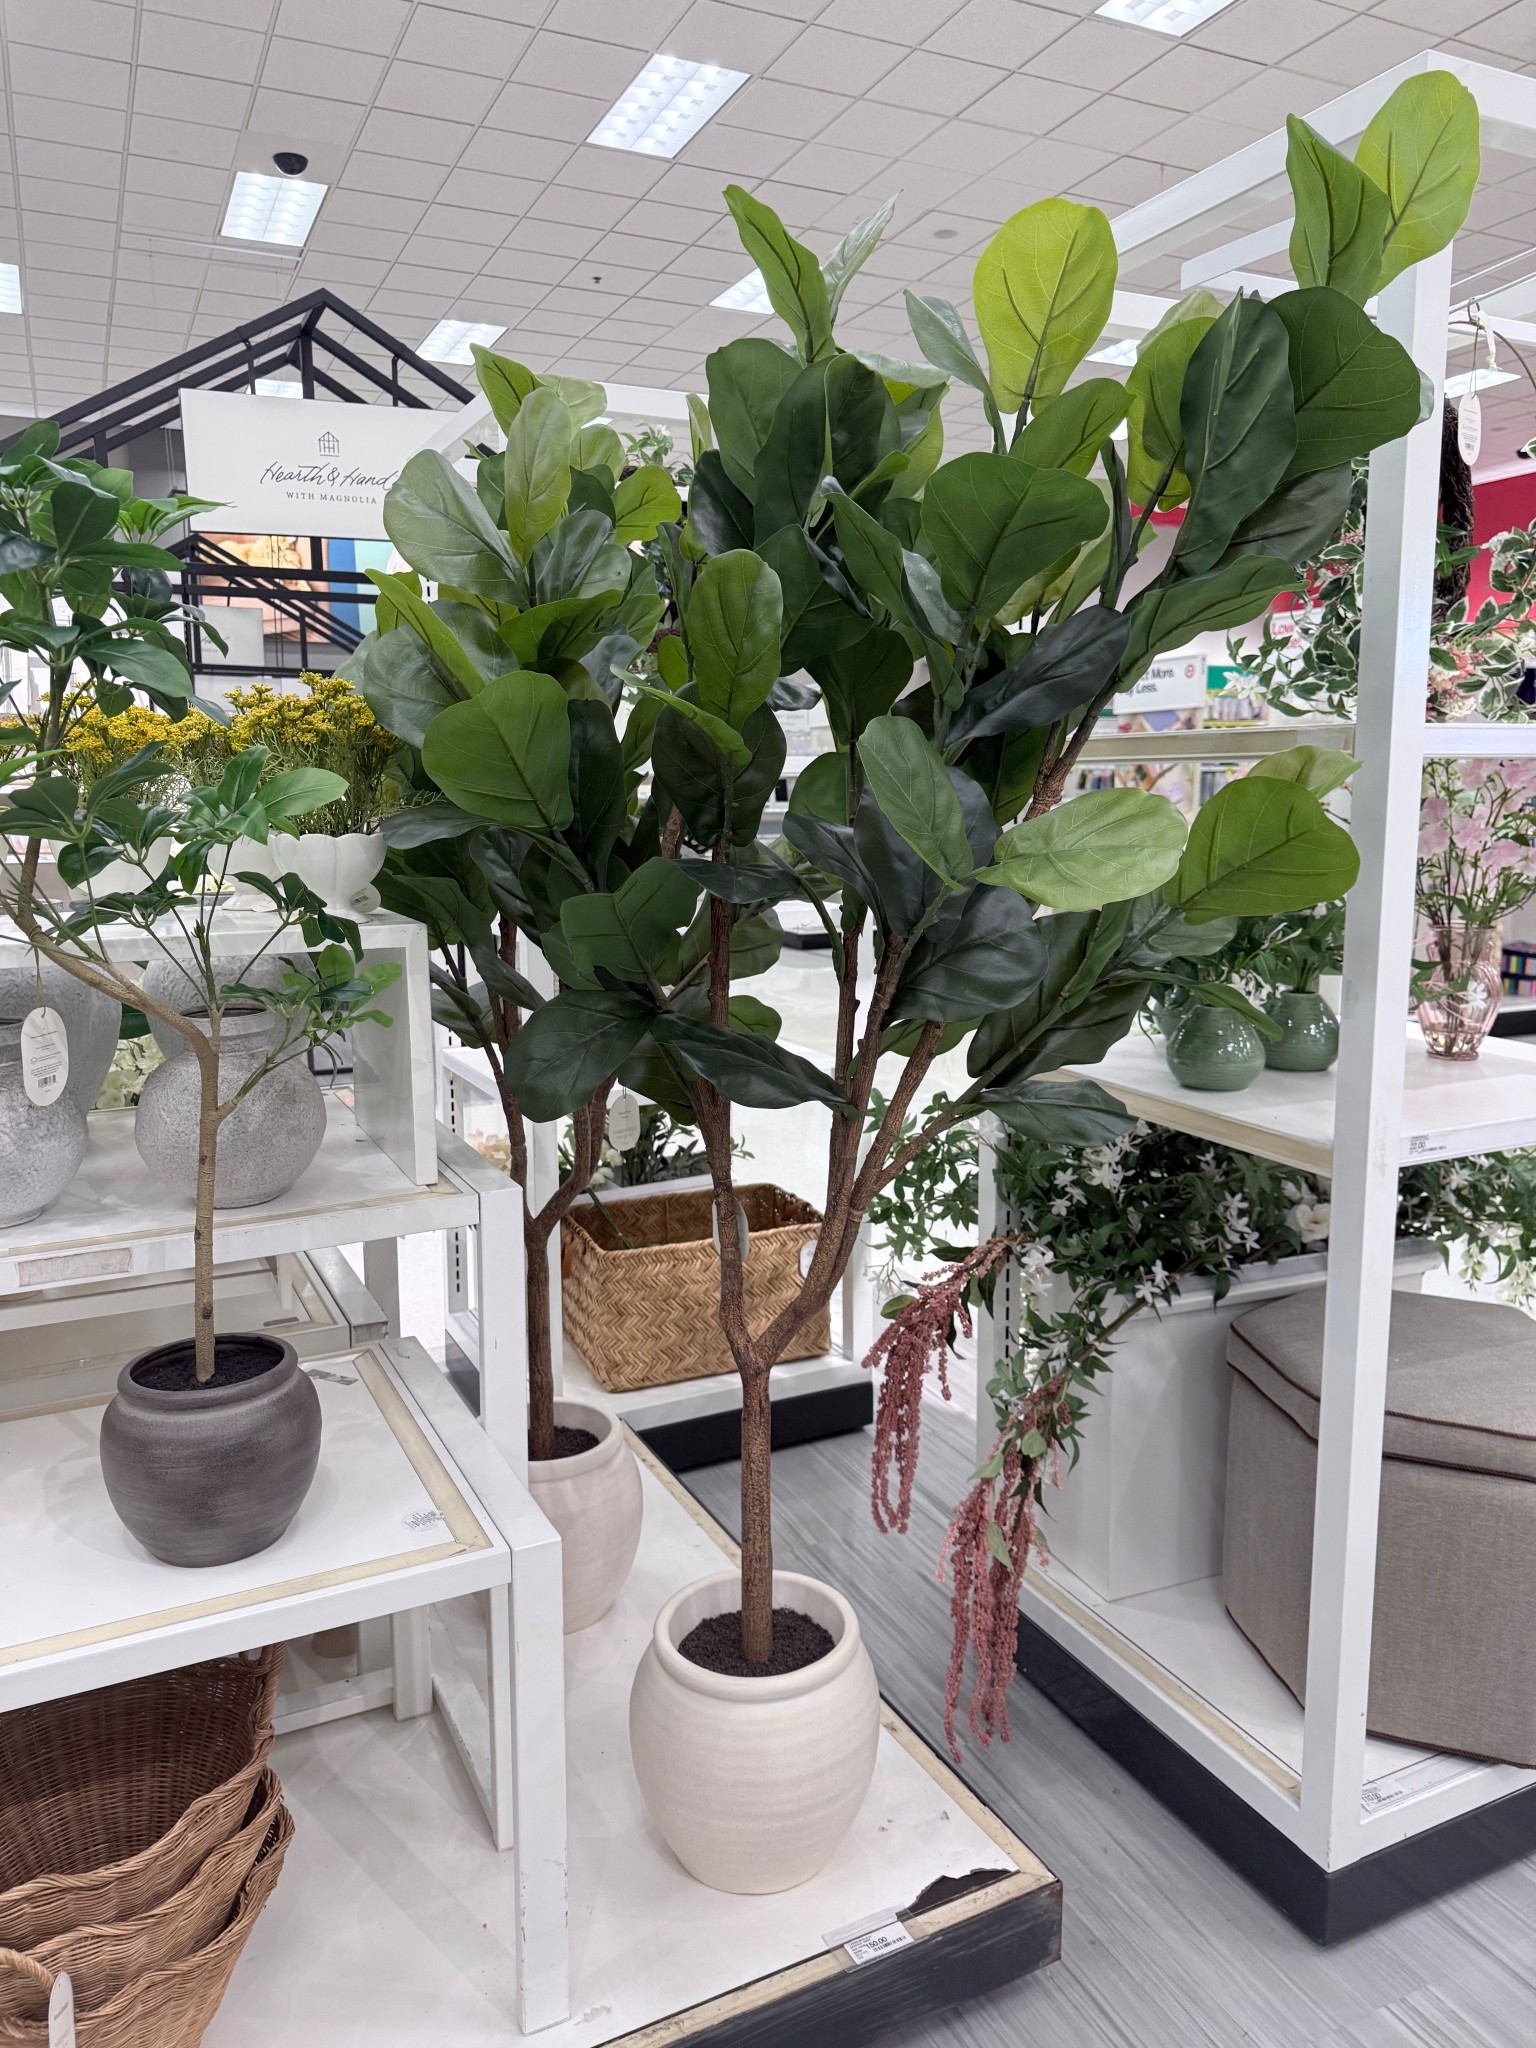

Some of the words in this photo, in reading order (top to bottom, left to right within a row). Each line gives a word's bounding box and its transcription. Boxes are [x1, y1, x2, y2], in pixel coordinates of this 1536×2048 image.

[260, 461, 330, 485] Hearth
[327, 467, 340, 487] &
[339, 467, 399, 491] Hand
[286, 491, 315, 501] WITH
[319, 493, 378, 505] MAGNOLIA
[865, 1936, 888, 1950] 150.00
